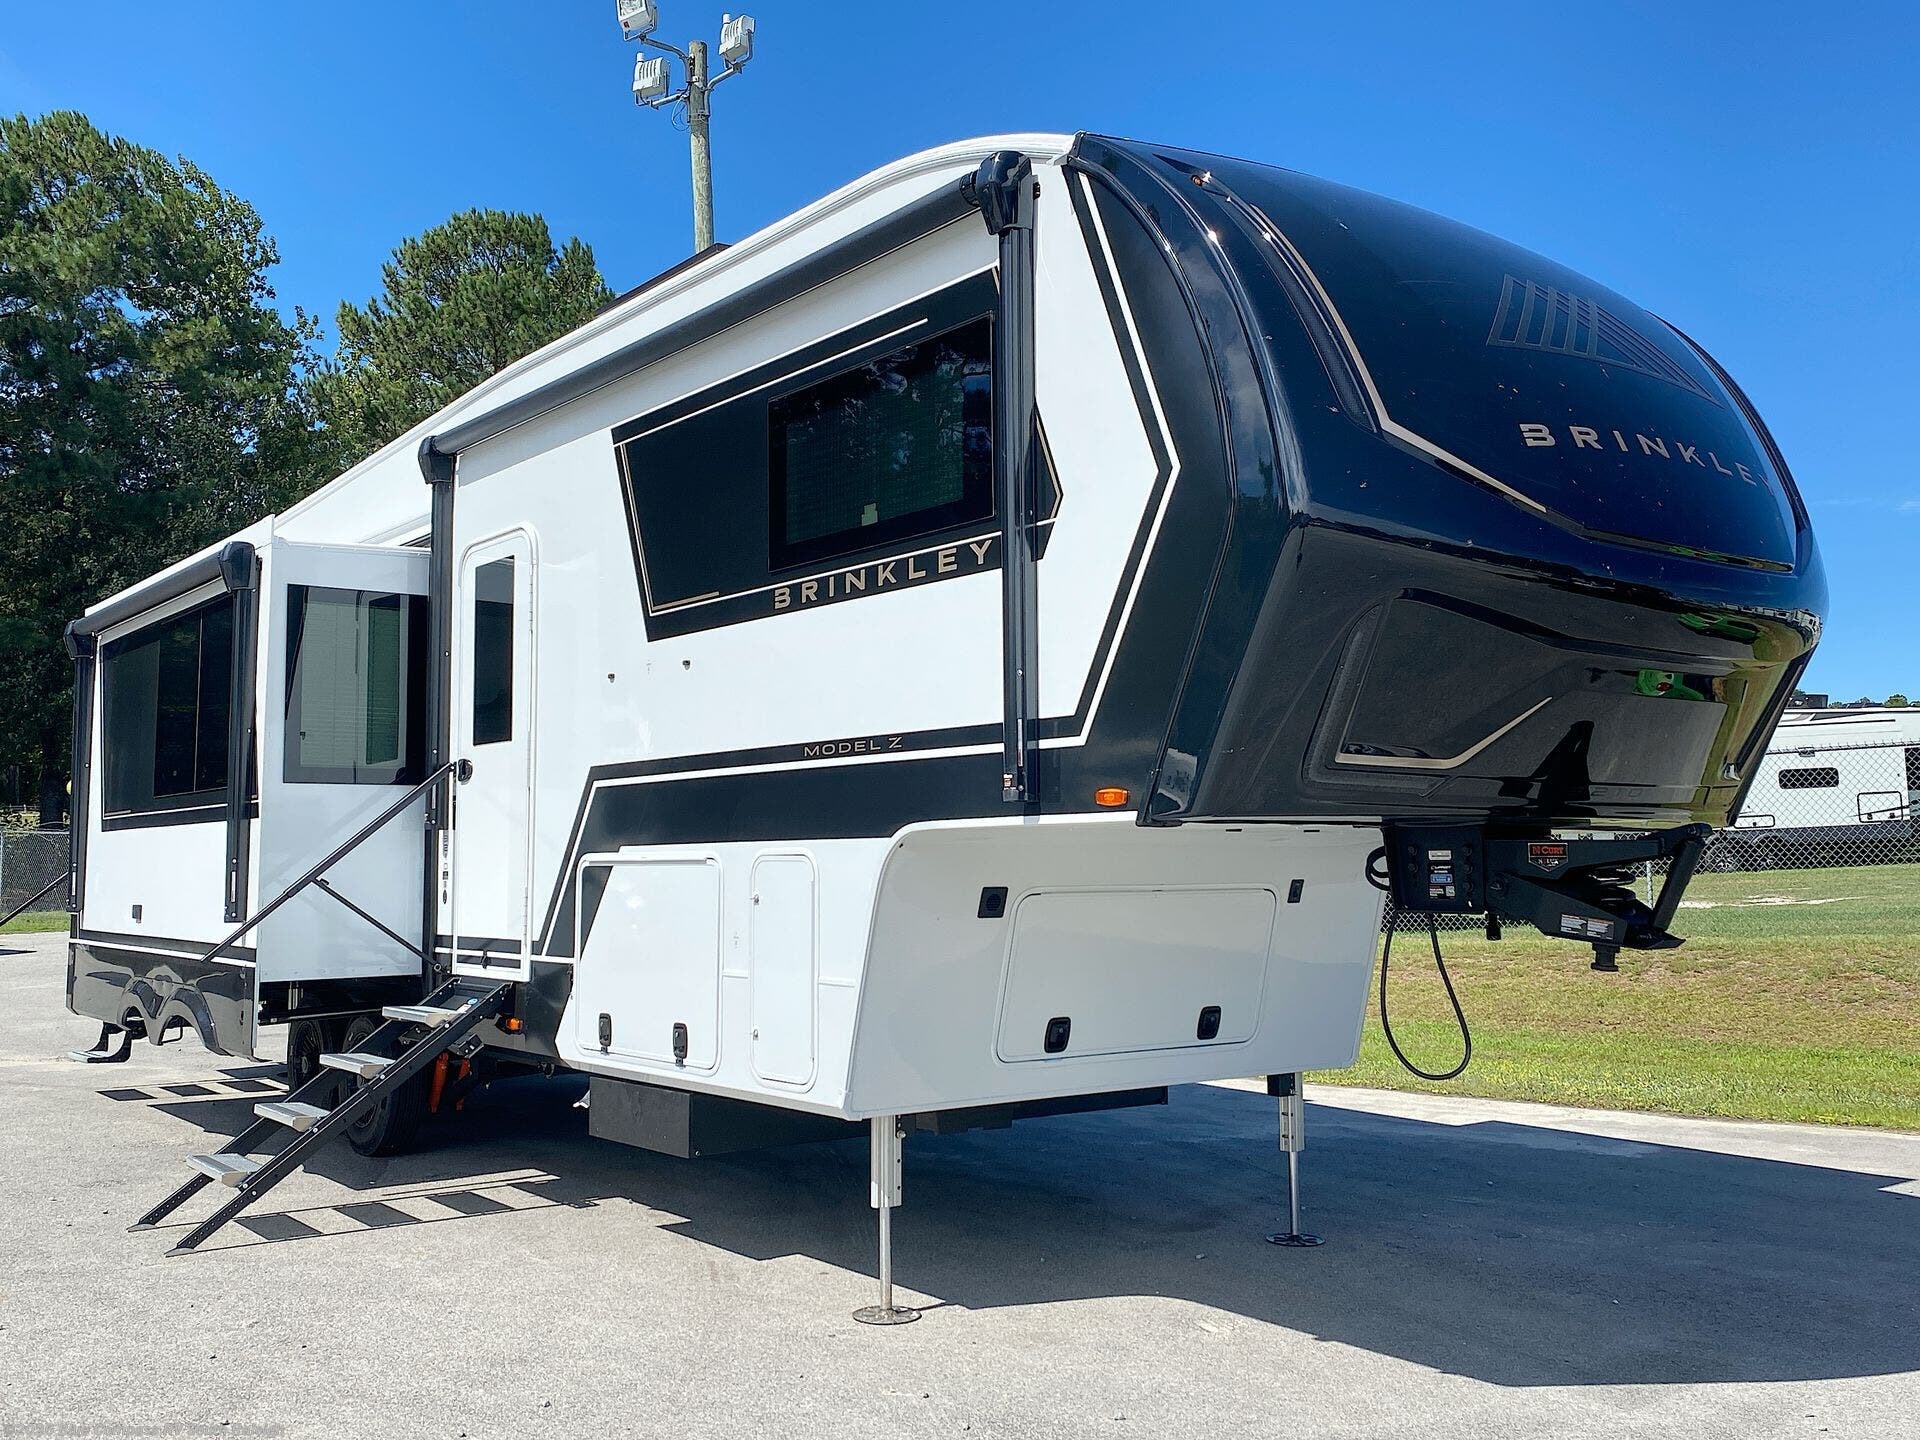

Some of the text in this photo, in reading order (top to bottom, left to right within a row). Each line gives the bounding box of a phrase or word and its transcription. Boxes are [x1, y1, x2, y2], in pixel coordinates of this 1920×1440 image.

[774, 539, 993, 610] BRINKLEY
[803, 736, 903, 757] MODEL Z
